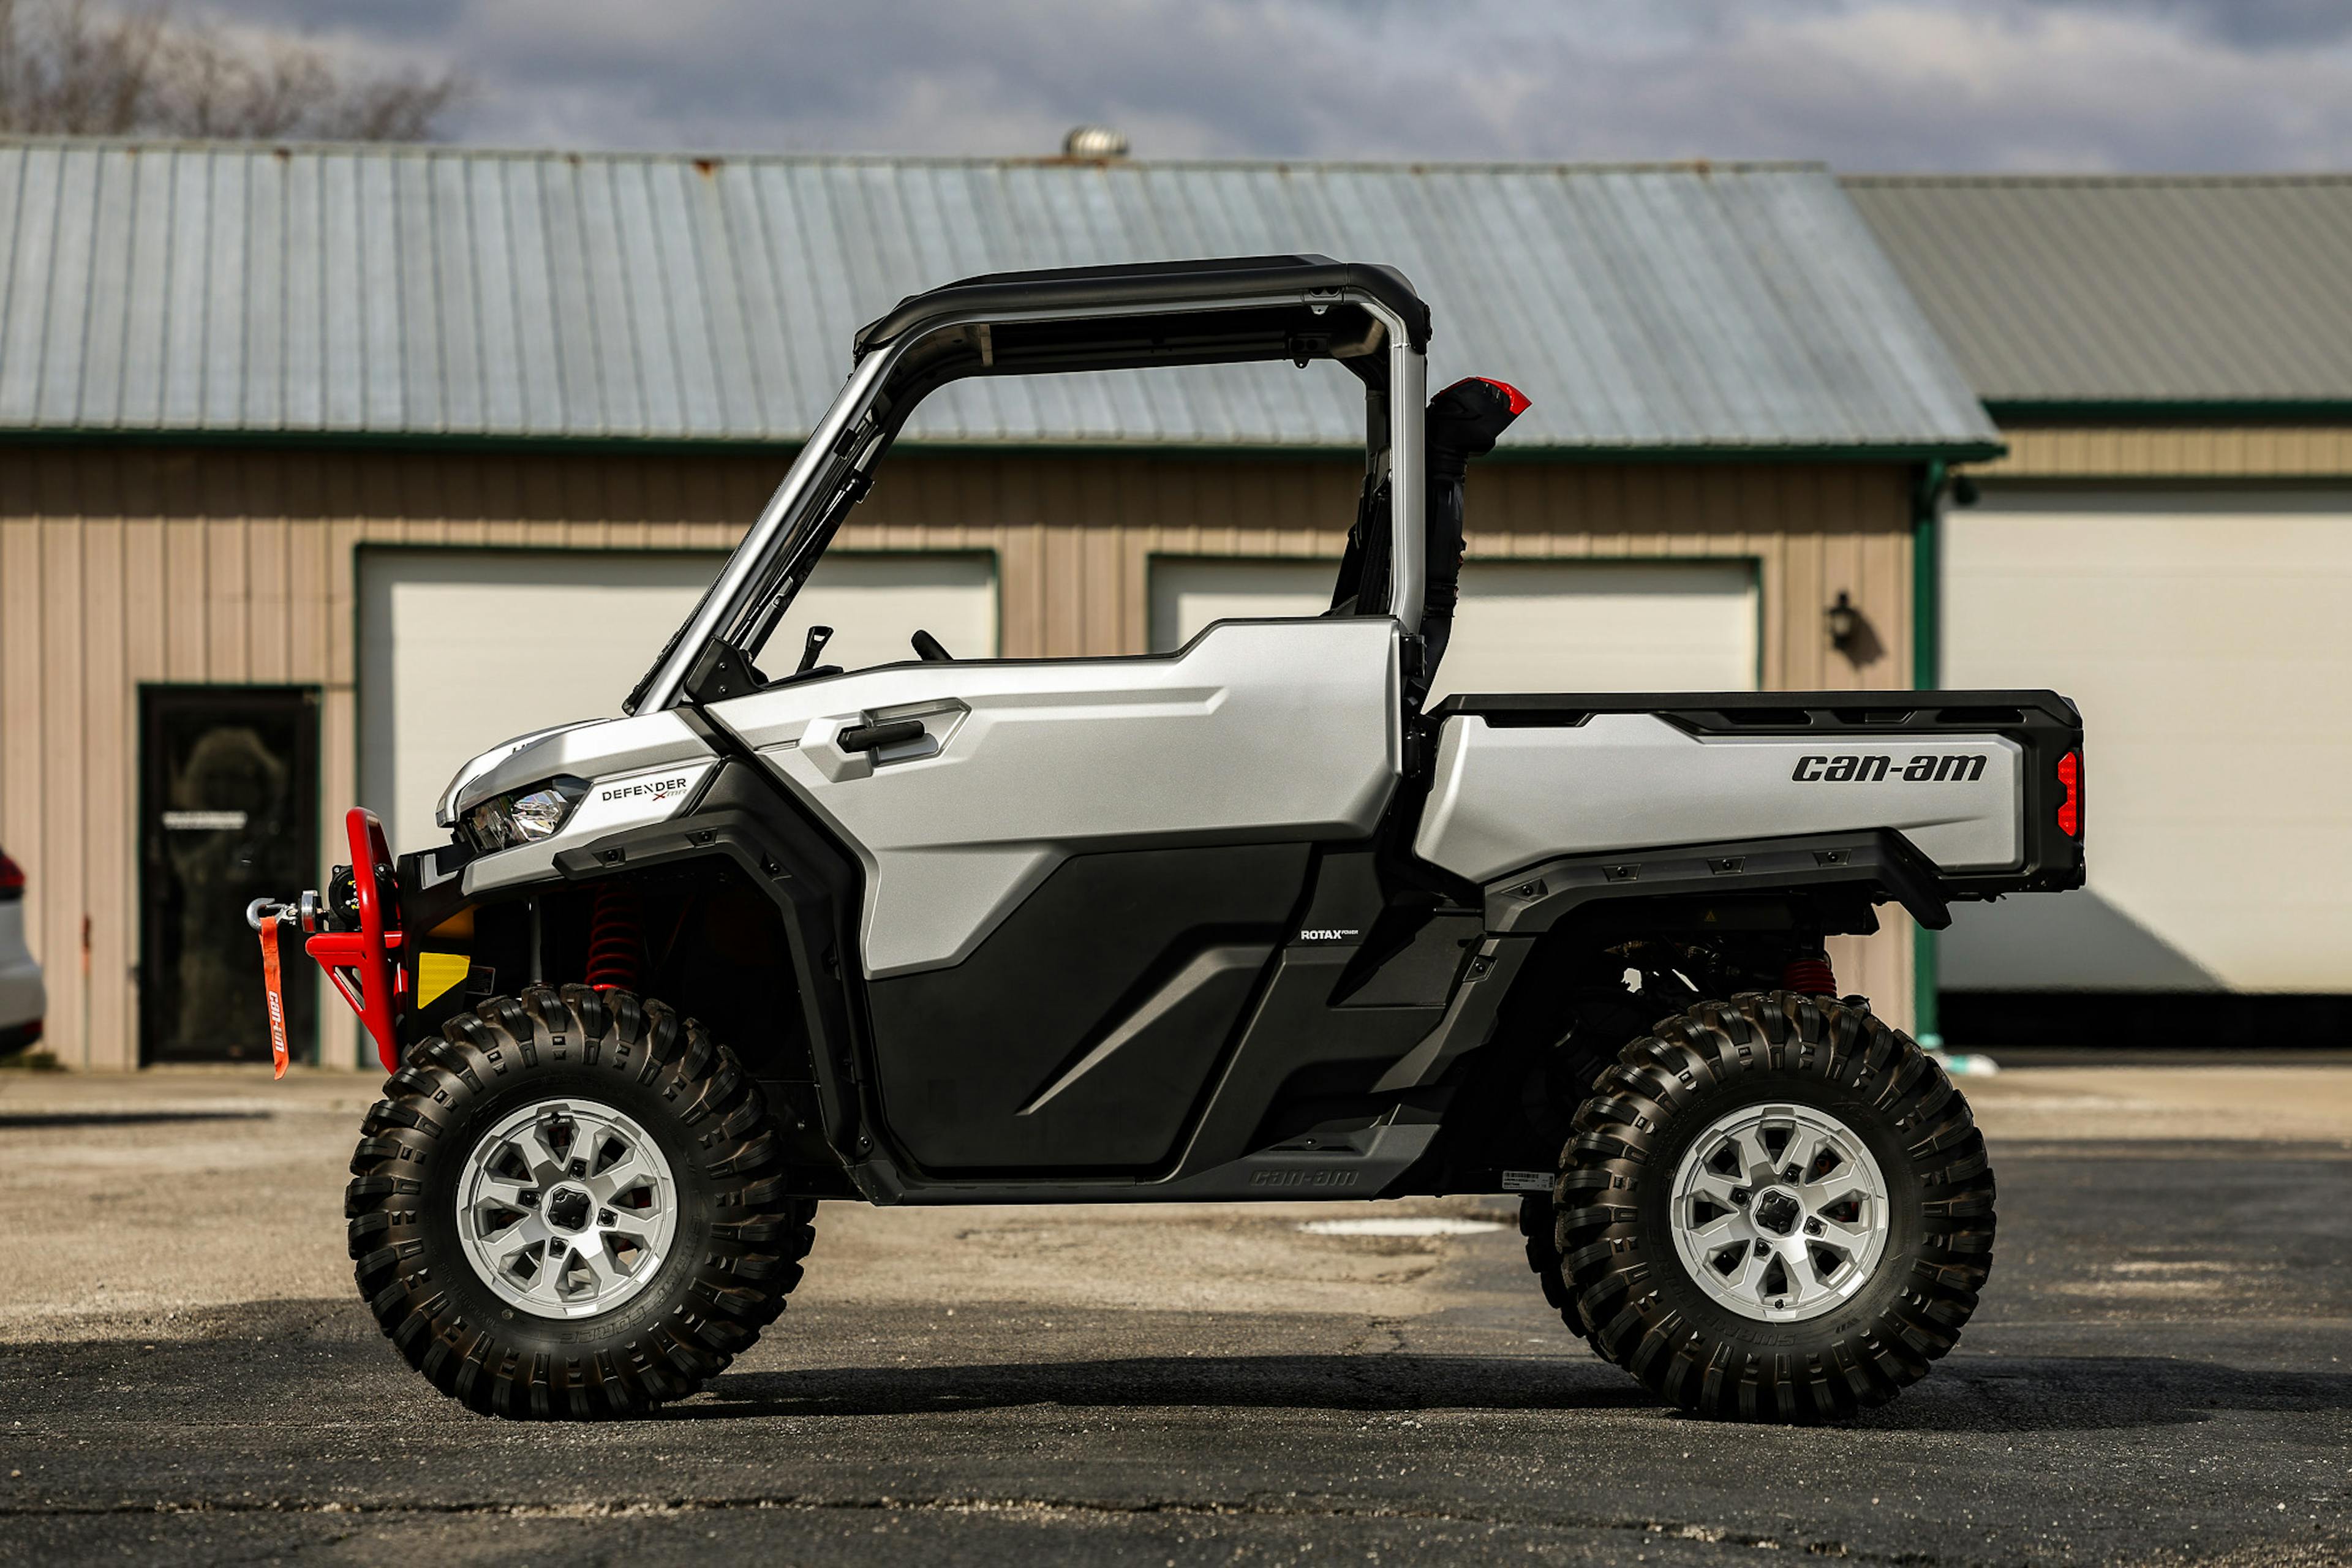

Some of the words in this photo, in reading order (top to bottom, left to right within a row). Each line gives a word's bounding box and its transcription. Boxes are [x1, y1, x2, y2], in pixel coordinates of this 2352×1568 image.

[1792, 755, 1987, 781] can-am
[602, 778, 686, 801] DEFENDER
[1300, 930, 1341, 940] ROTAX
[1249, 1169, 1360, 1186] can-am
